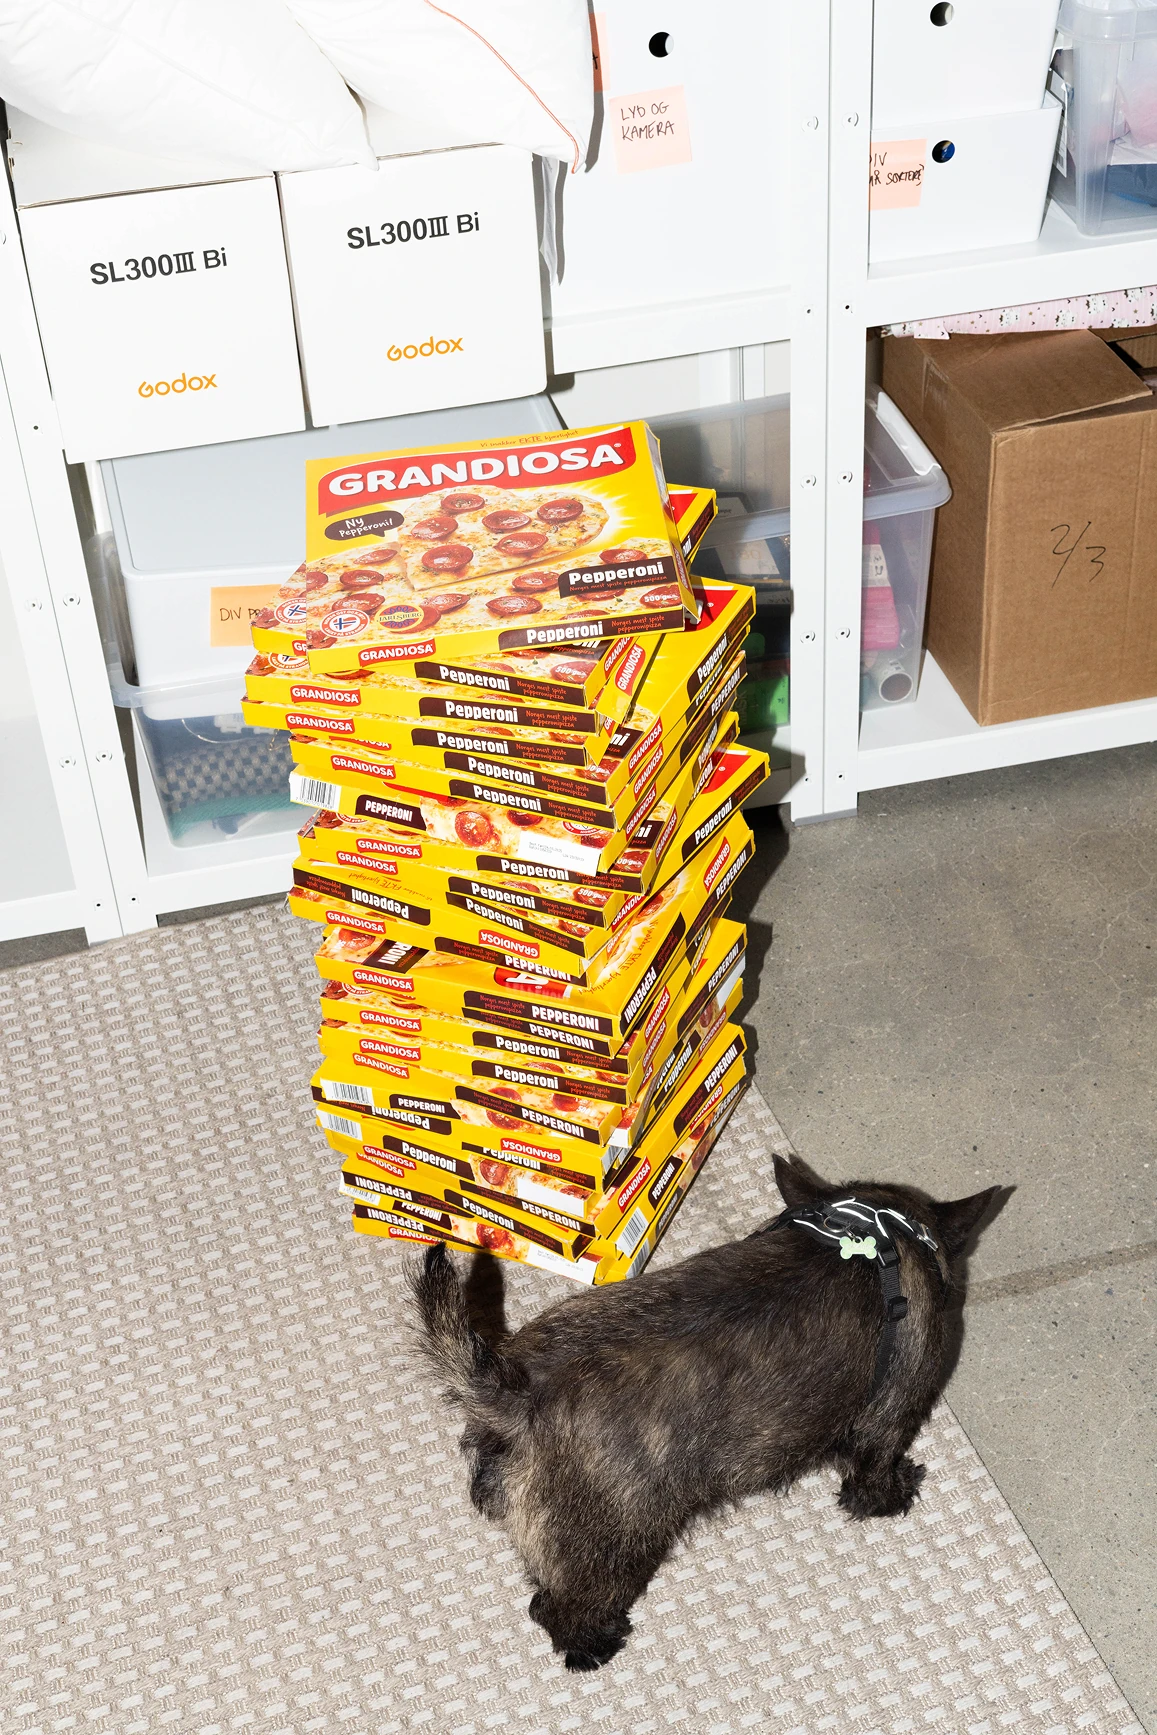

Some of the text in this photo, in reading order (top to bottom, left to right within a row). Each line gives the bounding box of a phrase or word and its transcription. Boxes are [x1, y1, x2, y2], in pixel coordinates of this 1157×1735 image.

[620, 101, 669, 121] LYD OG
[621, 120, 675, 141] KAMERA
[457, 211, 481, 235] Bi
[203, 246, 228, 270] Bi
[386, 336, 464, 362] Godox
[138, 372, 218, 398] Godox
[519, 435, 543, 444] EKTE
[328, 443, 624, 496] GRANDIOSA
[338, 518, 393, 537] Pepperoni!
[345, 518, 364, 529] Ny
[1050, 520, 1107, 588] 2/3
[568, 561, 664, 585] Pepperoni
[219, 608, 242, 622] DIV
[376, 611, 423, 623] JARLSBERG
[611, 615, 665, 629] Norges mest spiste
[526, 620, 604, 644] Pepperoni
[617, 622, 662, 633] pepperonipizza
[360, 643, 433, 661] GRANDIOSA
[697, 633, 728, 684] Pepperoni
[440, 666, 510, 691] Pepperoni
[617, 644, 643, 690] GRANDIOSA
[292, 688, 358, 703] GRANDIOSA
[517, 681, 536, 689] Norges
[551, 687, 567, 695] spiste
[523, 688, 564, 700] pepperonipizza
[711, 667, 741, 716] PEPPERONI
[445, 701, 518, 722] Pepperoni
[526, 711, 545, 719] Norges
[562, 714, 577, 722] spiste
[532, 718, 574, 728] pepperonipizza
[288, 716, 352, 731] GRANDIOSA
[437, 732, 509, 754] Pepperoni
[516, 743, 535, 752] Norges
[551, 748, 567, 757] spiste
[630, 724, 662, 769] GRANDIOSA
[332, 757, 394, 777] GRANDIOSA
[522, 752, 564, 762] pepperonipizza
[468, 757, 535, 785] Pepperoni
[634, 747, 662, 794] GRANDIOSA
[542, 776, 590, 792] Norges mest spiste
[547, 785, 588, 797] pepperonipizza
[473, 785, 542, 811] Pepperoni
[548, 803, 566, 811] Norges
[365, 800, 412, 822] PEPPERONI
[554, 810, 595, 822] pepperonipizza
[626, 788, 656, 834] GRANDIOSA
[695, 797, 732, 845] Pepperoni
[357, 838, 420, 857] GRANDIOSA
[338, 852, 396, 873] GRANDIOSA
[501, 859, 569, 880] Pepperoni
[704, 844, 730, 887] GRANDIOSA
[716, 850, 747, 899] PEPPERONI
[352, 888, 409, 919] Pepperoni
[471, 882, 535, 909] Pepperoni
[327, 912, 384, 932] GRANDIOSA
[466, 898, 524, 931] Pepperoni
[481, 931, 538, 956] GRANDIOSA
[505, 955, 571, 981] PEPPERONI
[708, 943, 739, 992] PEPPERONI
[354, 971, 412, 990] GRANDIOSA
[624, 967, 657, 1020] PEPPERONI
[361, 1012, 420, 1030] GRANDIOSA
[532, 1006, 599, 1031] PEPPERONI
[645, 992, 670, 1038] GRANDIOSA
[496, 1036, 559, 1059] Pepperoni
[529, 1024, 594, 1050] PEPPERONI
[361, 1041, 419, 1059] GRANDIOSA
[354, 1054, 408, 1077] GRANDIOSA
[495, 1065, 558, 1089] Pepperoni
[704, 1044, 738, 1092] PEPPERONI
[398, 1098, 445, 1113] PEPPERONI
[372, 1106, 430, 1129] Pepperoni
[521, 1108, 584, 1137] PEPPERONI
[364, 1147, 415, 1168] GRANDIOSA
[402, 1142, 456, 1172] Pepperoni
[502, 1140, 560, 1161] GRANDIOSA
[355, 1177, 412, 1201] PEPPERONI
[618, 1164, 651, 1207] GRANDIOSA
[651, 1162, 675, 1200] PEPPERONI
[367, 1208, 424, 1232] PEPPERONI
[401, 1202, 442, 1221] PEPPERONI
[462, 1198, 514, 1230] Pepperoni
[522, 1201, 581, 1231] PEPPERONI
